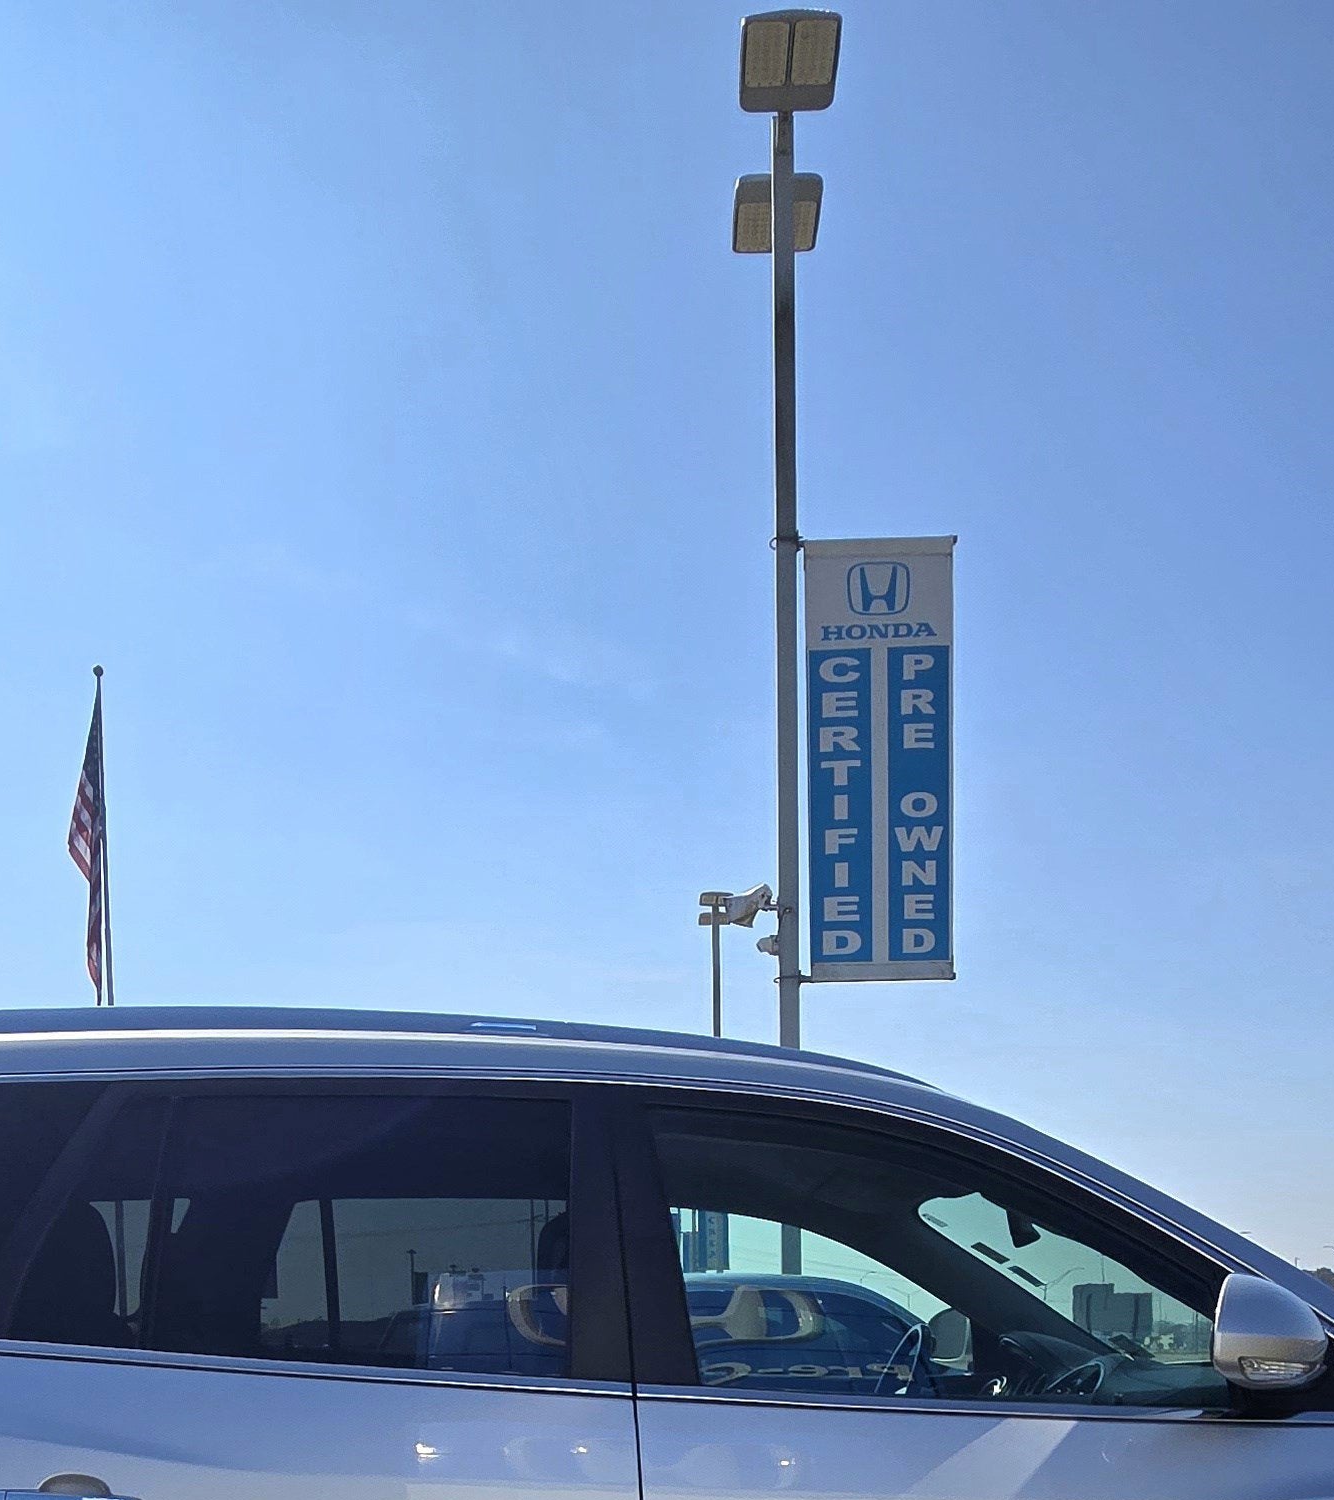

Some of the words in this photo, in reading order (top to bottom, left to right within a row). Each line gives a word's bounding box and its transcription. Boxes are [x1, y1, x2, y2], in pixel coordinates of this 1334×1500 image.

[821, 622, 937, 641] HONDA
[901, 654, 936, 749] PRE
[818, 655, 862, 957] CERTIFIED
[894, 791, 943, 955] OWNED
